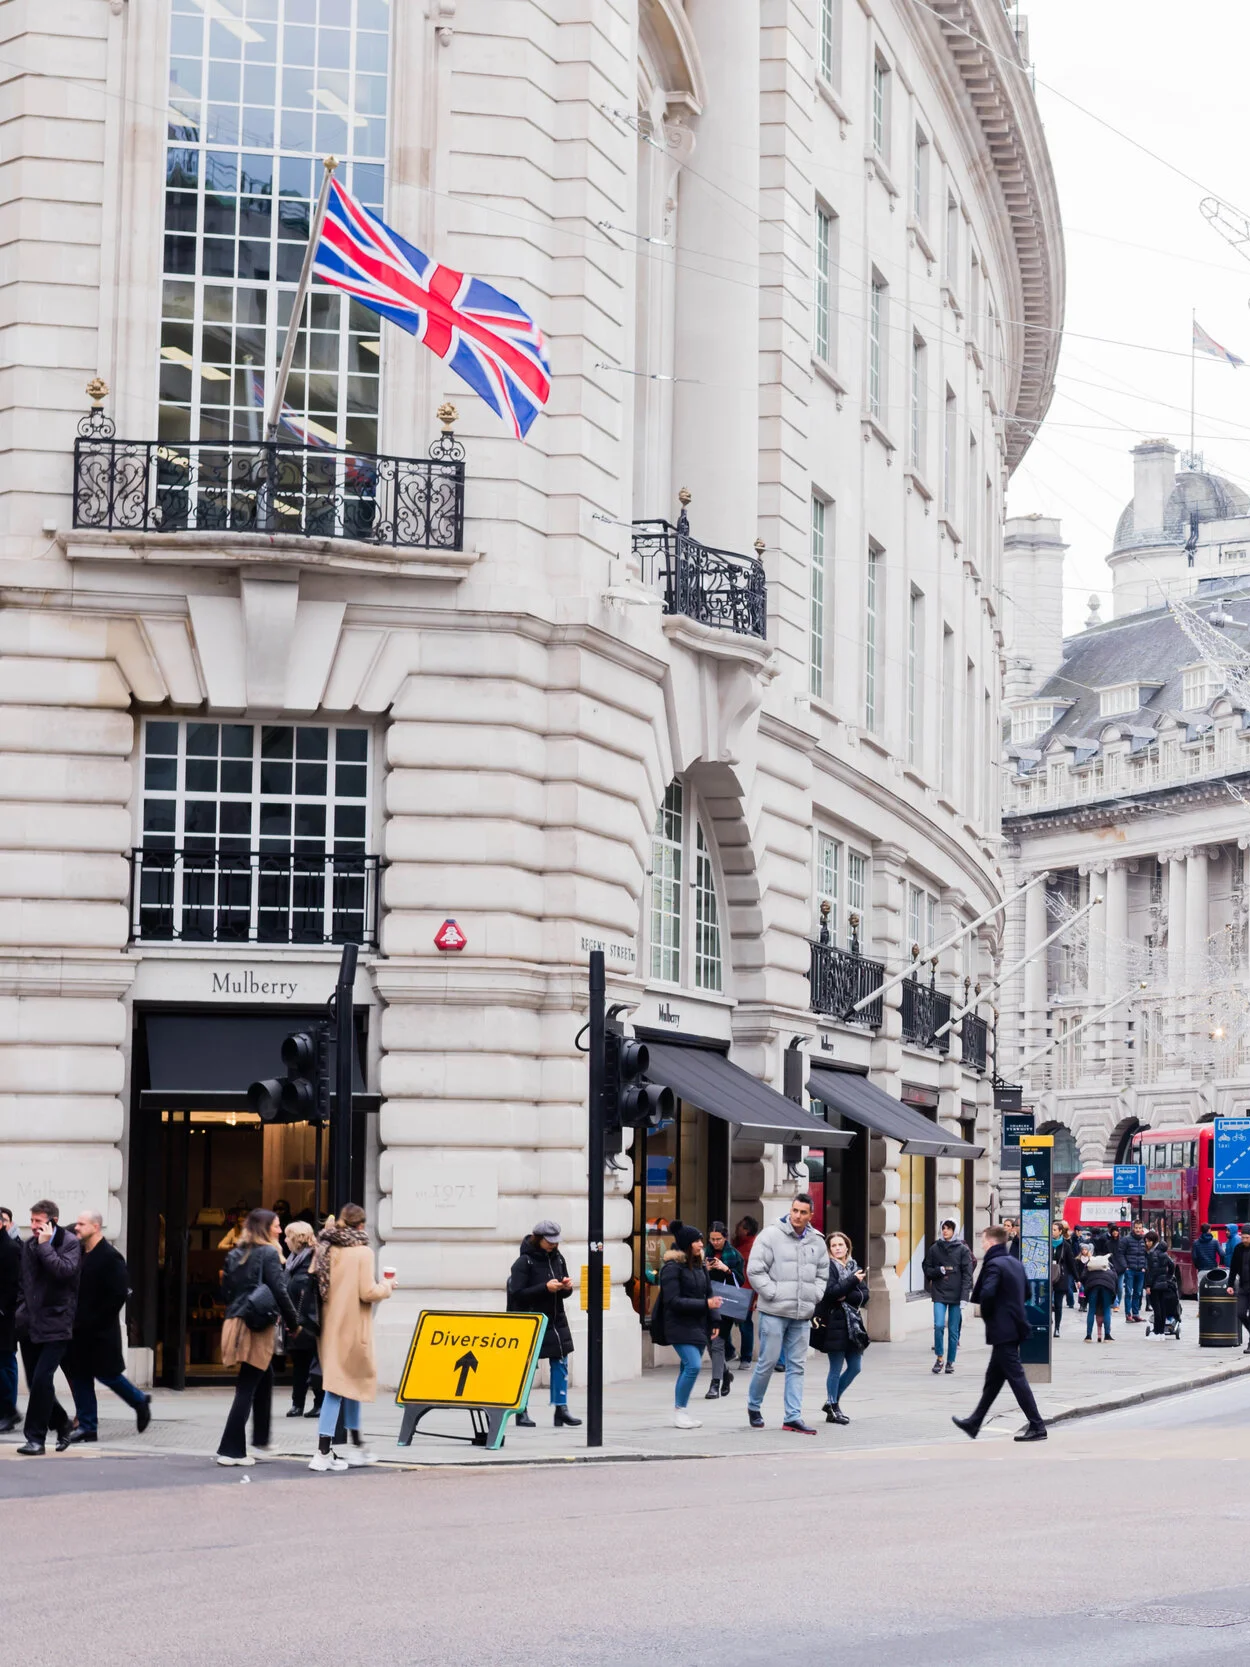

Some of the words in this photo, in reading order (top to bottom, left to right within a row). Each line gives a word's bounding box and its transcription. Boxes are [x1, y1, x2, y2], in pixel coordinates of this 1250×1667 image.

[581, 937, 606, 953] REGENT
[610, 944, 632, 961] STREET
[212, 970, 298, 999] Mulberry
[17, 1180, 88, 1204] Mulberry
[430, 1330, 519, 1350] Diversion
